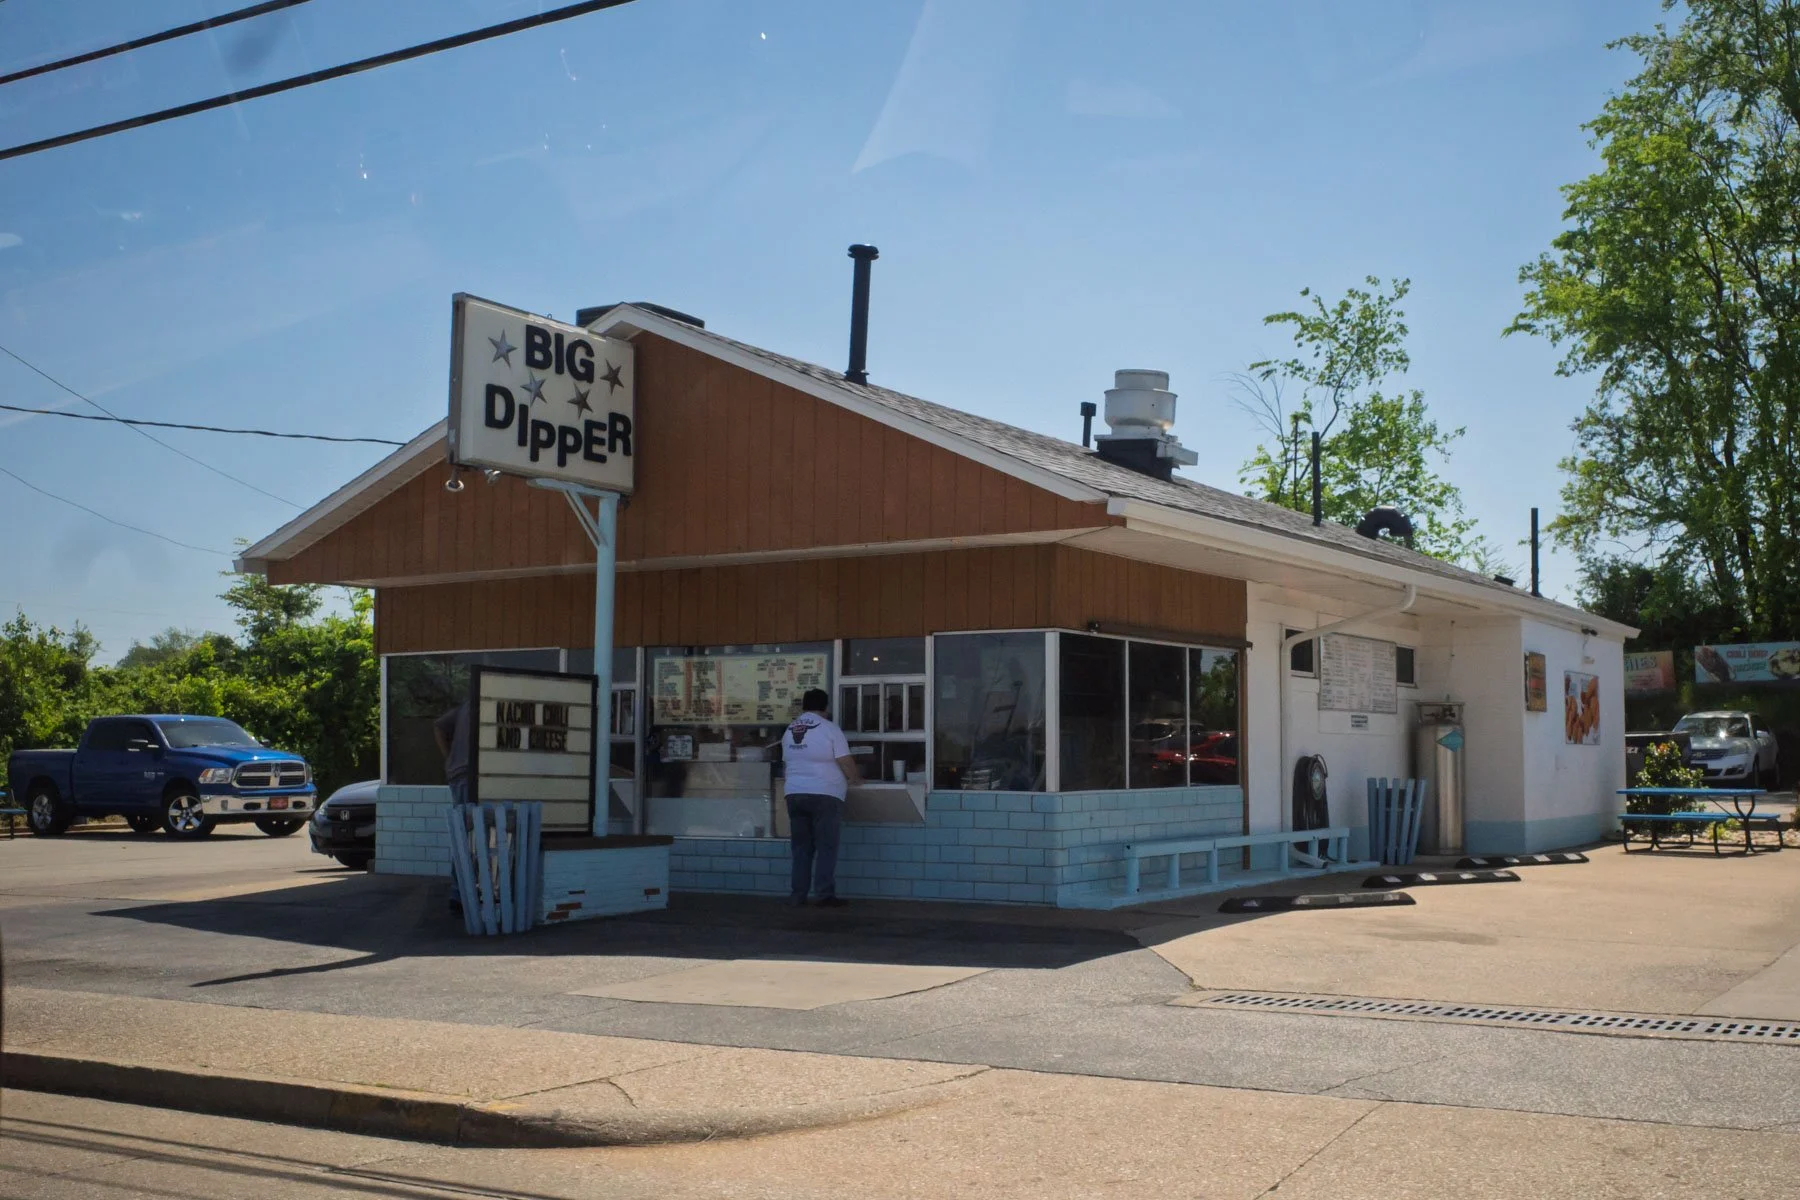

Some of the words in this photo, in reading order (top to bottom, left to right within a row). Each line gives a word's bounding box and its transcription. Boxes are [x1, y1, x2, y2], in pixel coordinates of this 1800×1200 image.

[525, 324, 595, 384] BIG
[484, 383, 632, 467] DIPPER
[496, 727, 521, 748] AND
